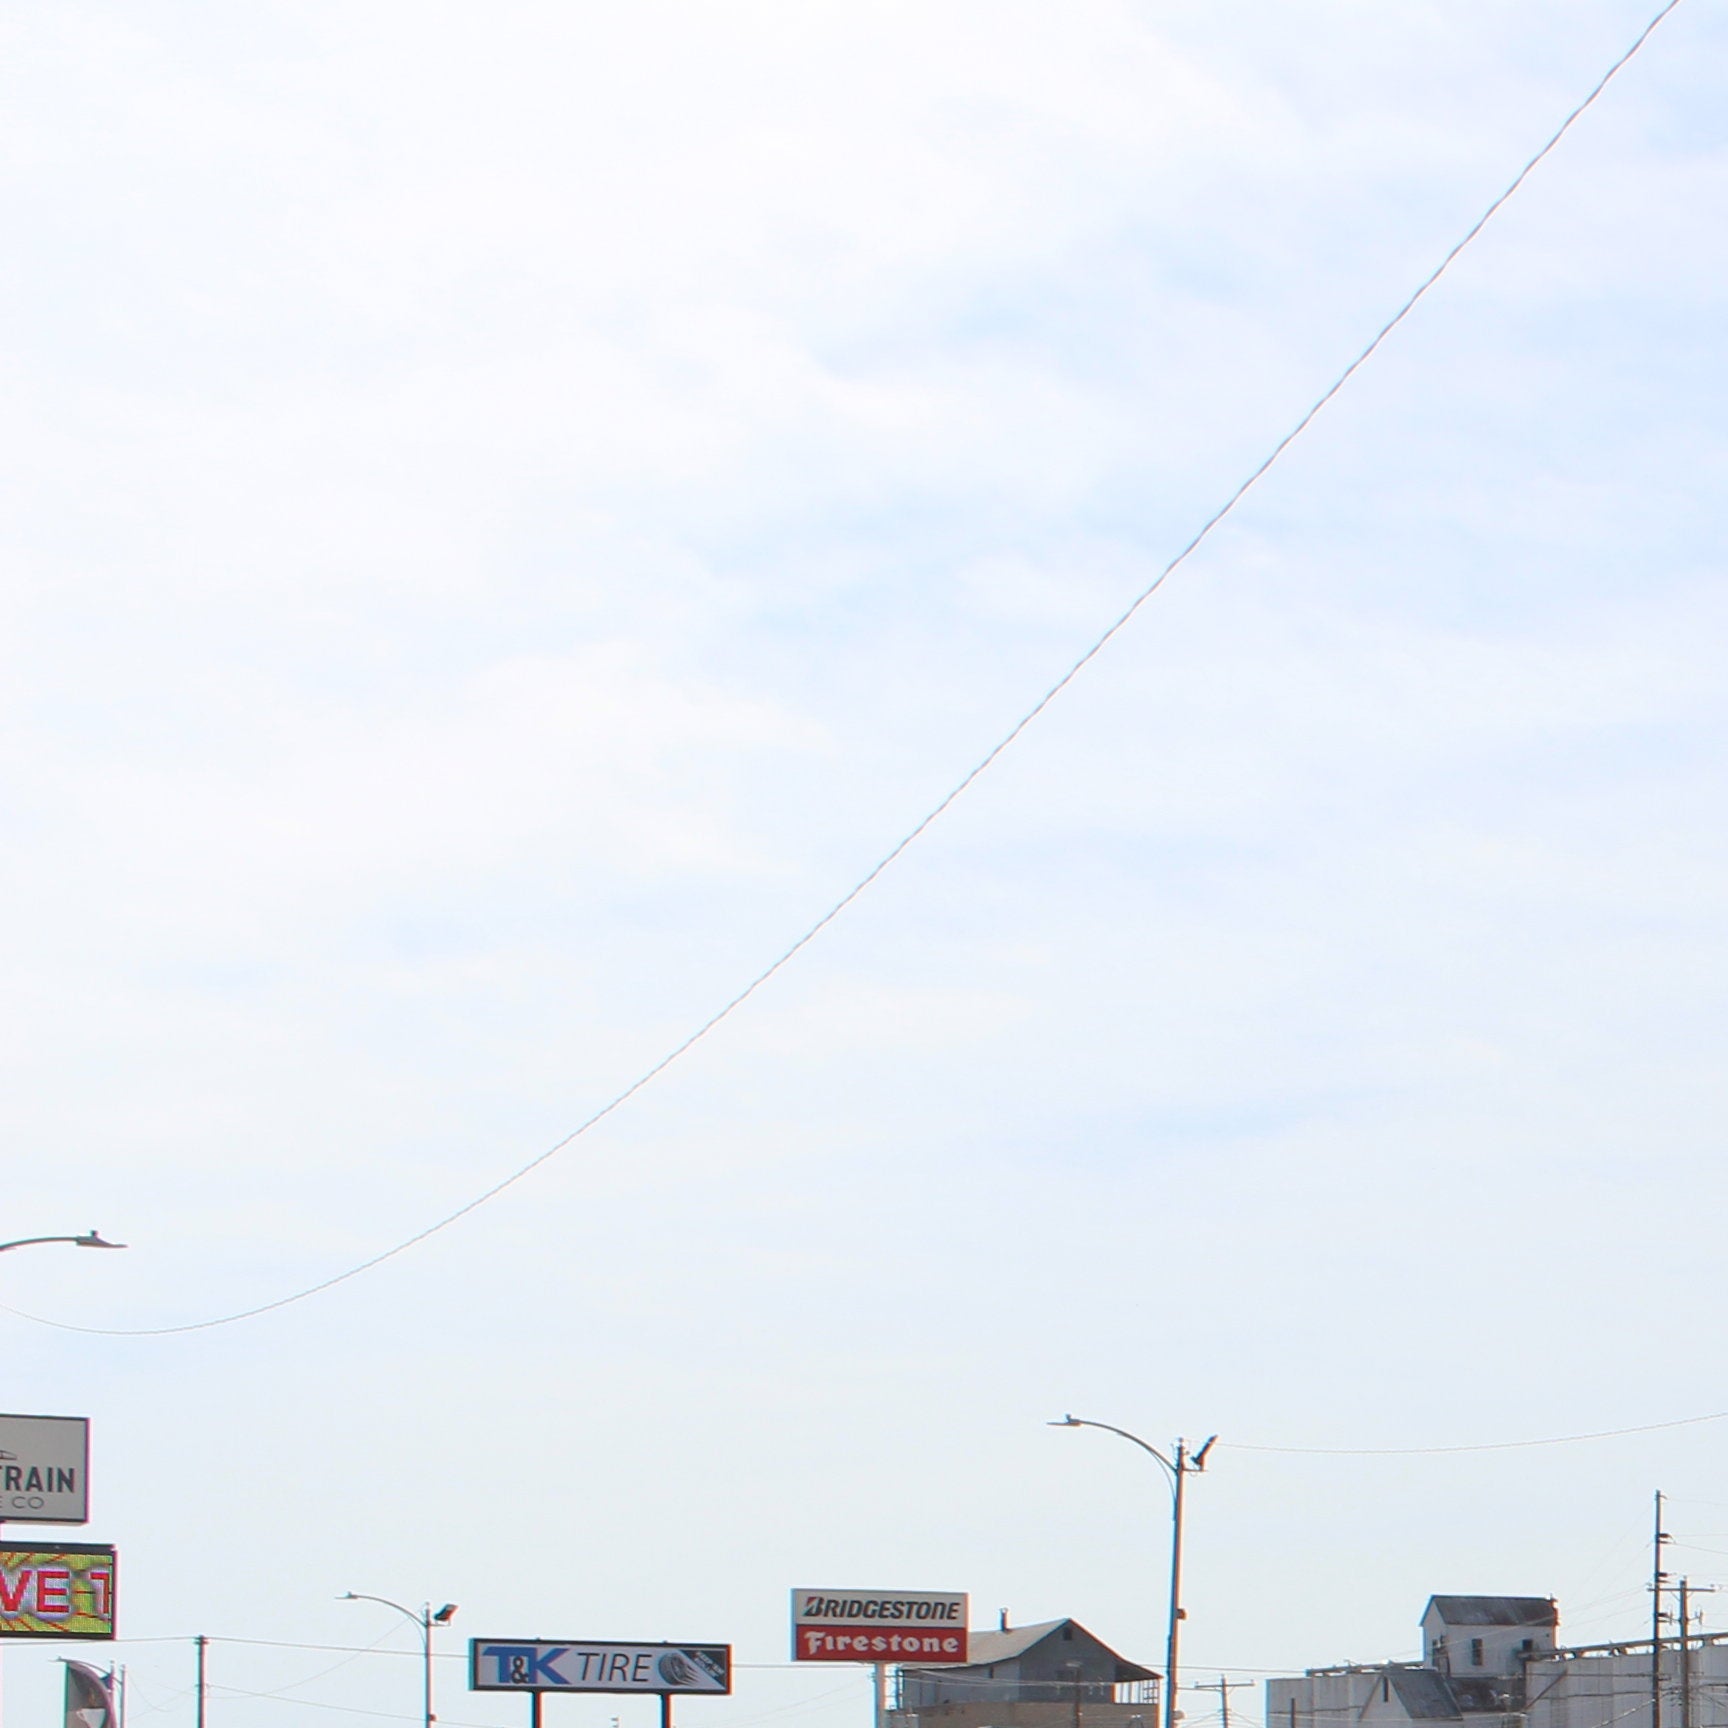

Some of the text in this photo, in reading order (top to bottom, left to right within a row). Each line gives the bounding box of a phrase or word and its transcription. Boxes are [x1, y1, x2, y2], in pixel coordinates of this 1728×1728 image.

[0, 1464, 75, 1493] RAIN
[12, 1496, 44, 1509] CO
[804, 1596, 961, 1620] BRIDGESTONE
[804, 1630, 959, 1655] Firestone
[483, 1646, 653, 1684] T&K TIRE
